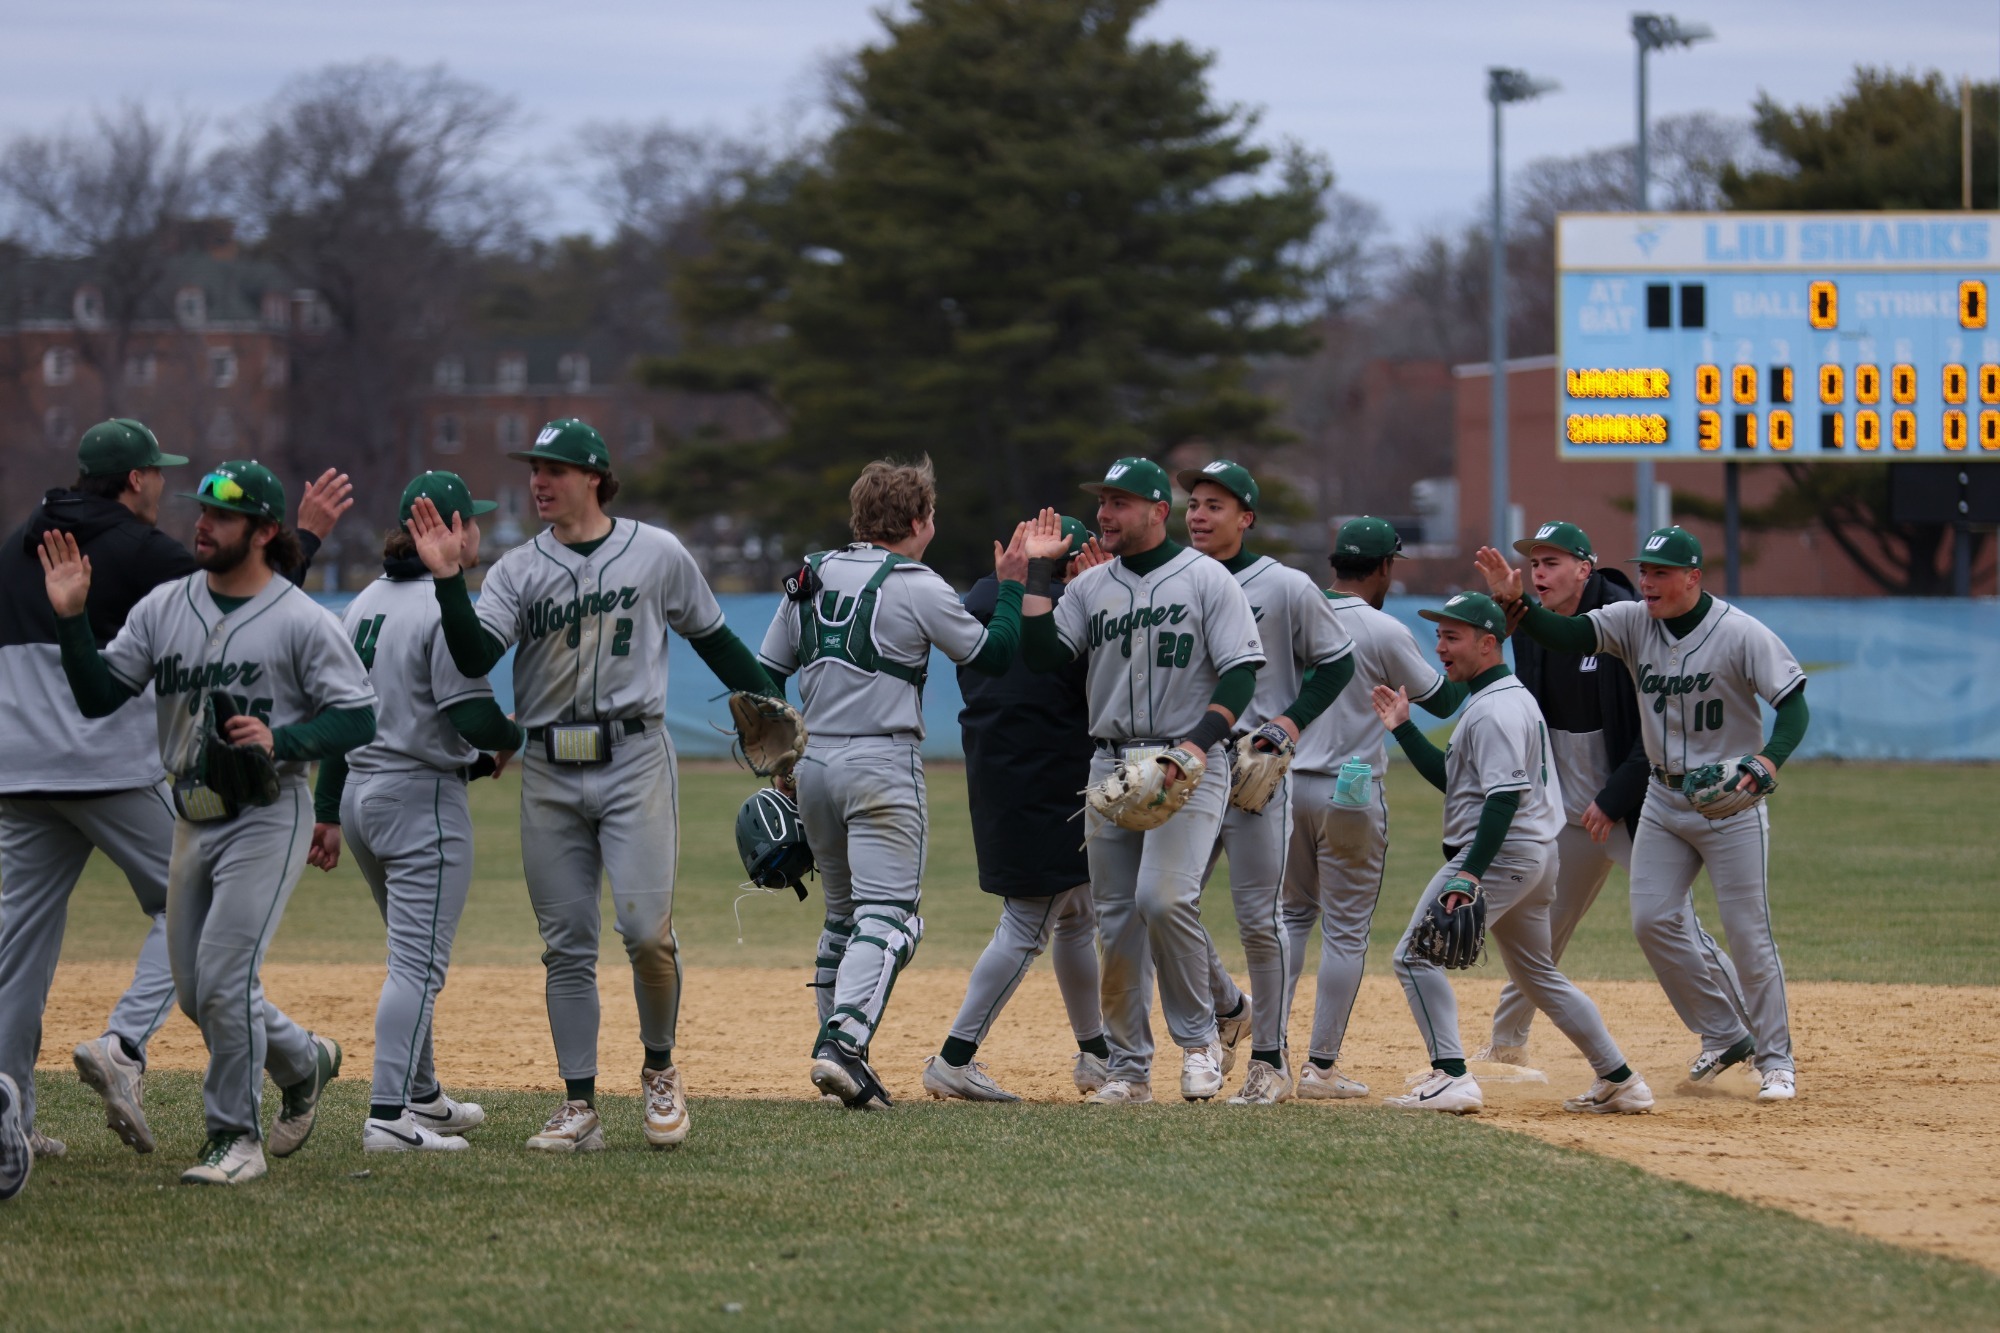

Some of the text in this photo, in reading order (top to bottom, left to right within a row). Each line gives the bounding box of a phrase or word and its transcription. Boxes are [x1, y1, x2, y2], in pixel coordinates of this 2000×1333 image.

[1704, 220, 1991, 261] LIU SHARKS
[1590, 279, 1627, 303] AT
[1733, 291, 1807, 318] BALL
[1809, 280, 1838, 329] 0
[1856, 289, 1958, 319] STRIKE
[1958, 280, 1987, 329] 0
[1579, 306, 1636, 332] BAT
[1702, 337, 1713, 362] 1
[1770, 338, 1790, 364] 3
[1822, 336, 1840, 363] 4
[1696, 364, 1721, 404] 0
[1732, 364, 1757, 404] 0
[1819, 364, 1844, 404] 0
[1856, 364, 1880, 404] 0
[1892, 364, 1916, 404] 0
[1943, 364, 1967, 404] 0
[1979, 364, 2000, 404] 0
[535, 427, 562, 446] W
[1698, 410, 1721, 450] 3
[1768, 410, 1793, 450] 0
[1856, 410, 1880, 450] 0
[1892, 410, 1916, 450] 0
[1943, 410, 1967, 450] 0
[1979, 410, 2000, 450] 0
[1105, 464, 1131, 481] W
[1535, 526, 1559, 540] W
[1645, 535, 1669, 551] W
[528, 585, 640, 649] Wagner
[1089, 603, 1188, 659] Wagner
[611, 617, 634, 656] 2
[1156, 631, 1195, 669] 28
[1579, 655, 1599, 673] W
[154, 652, 264, 717] Wagner
[1694, 698, 1724, 732] 10
